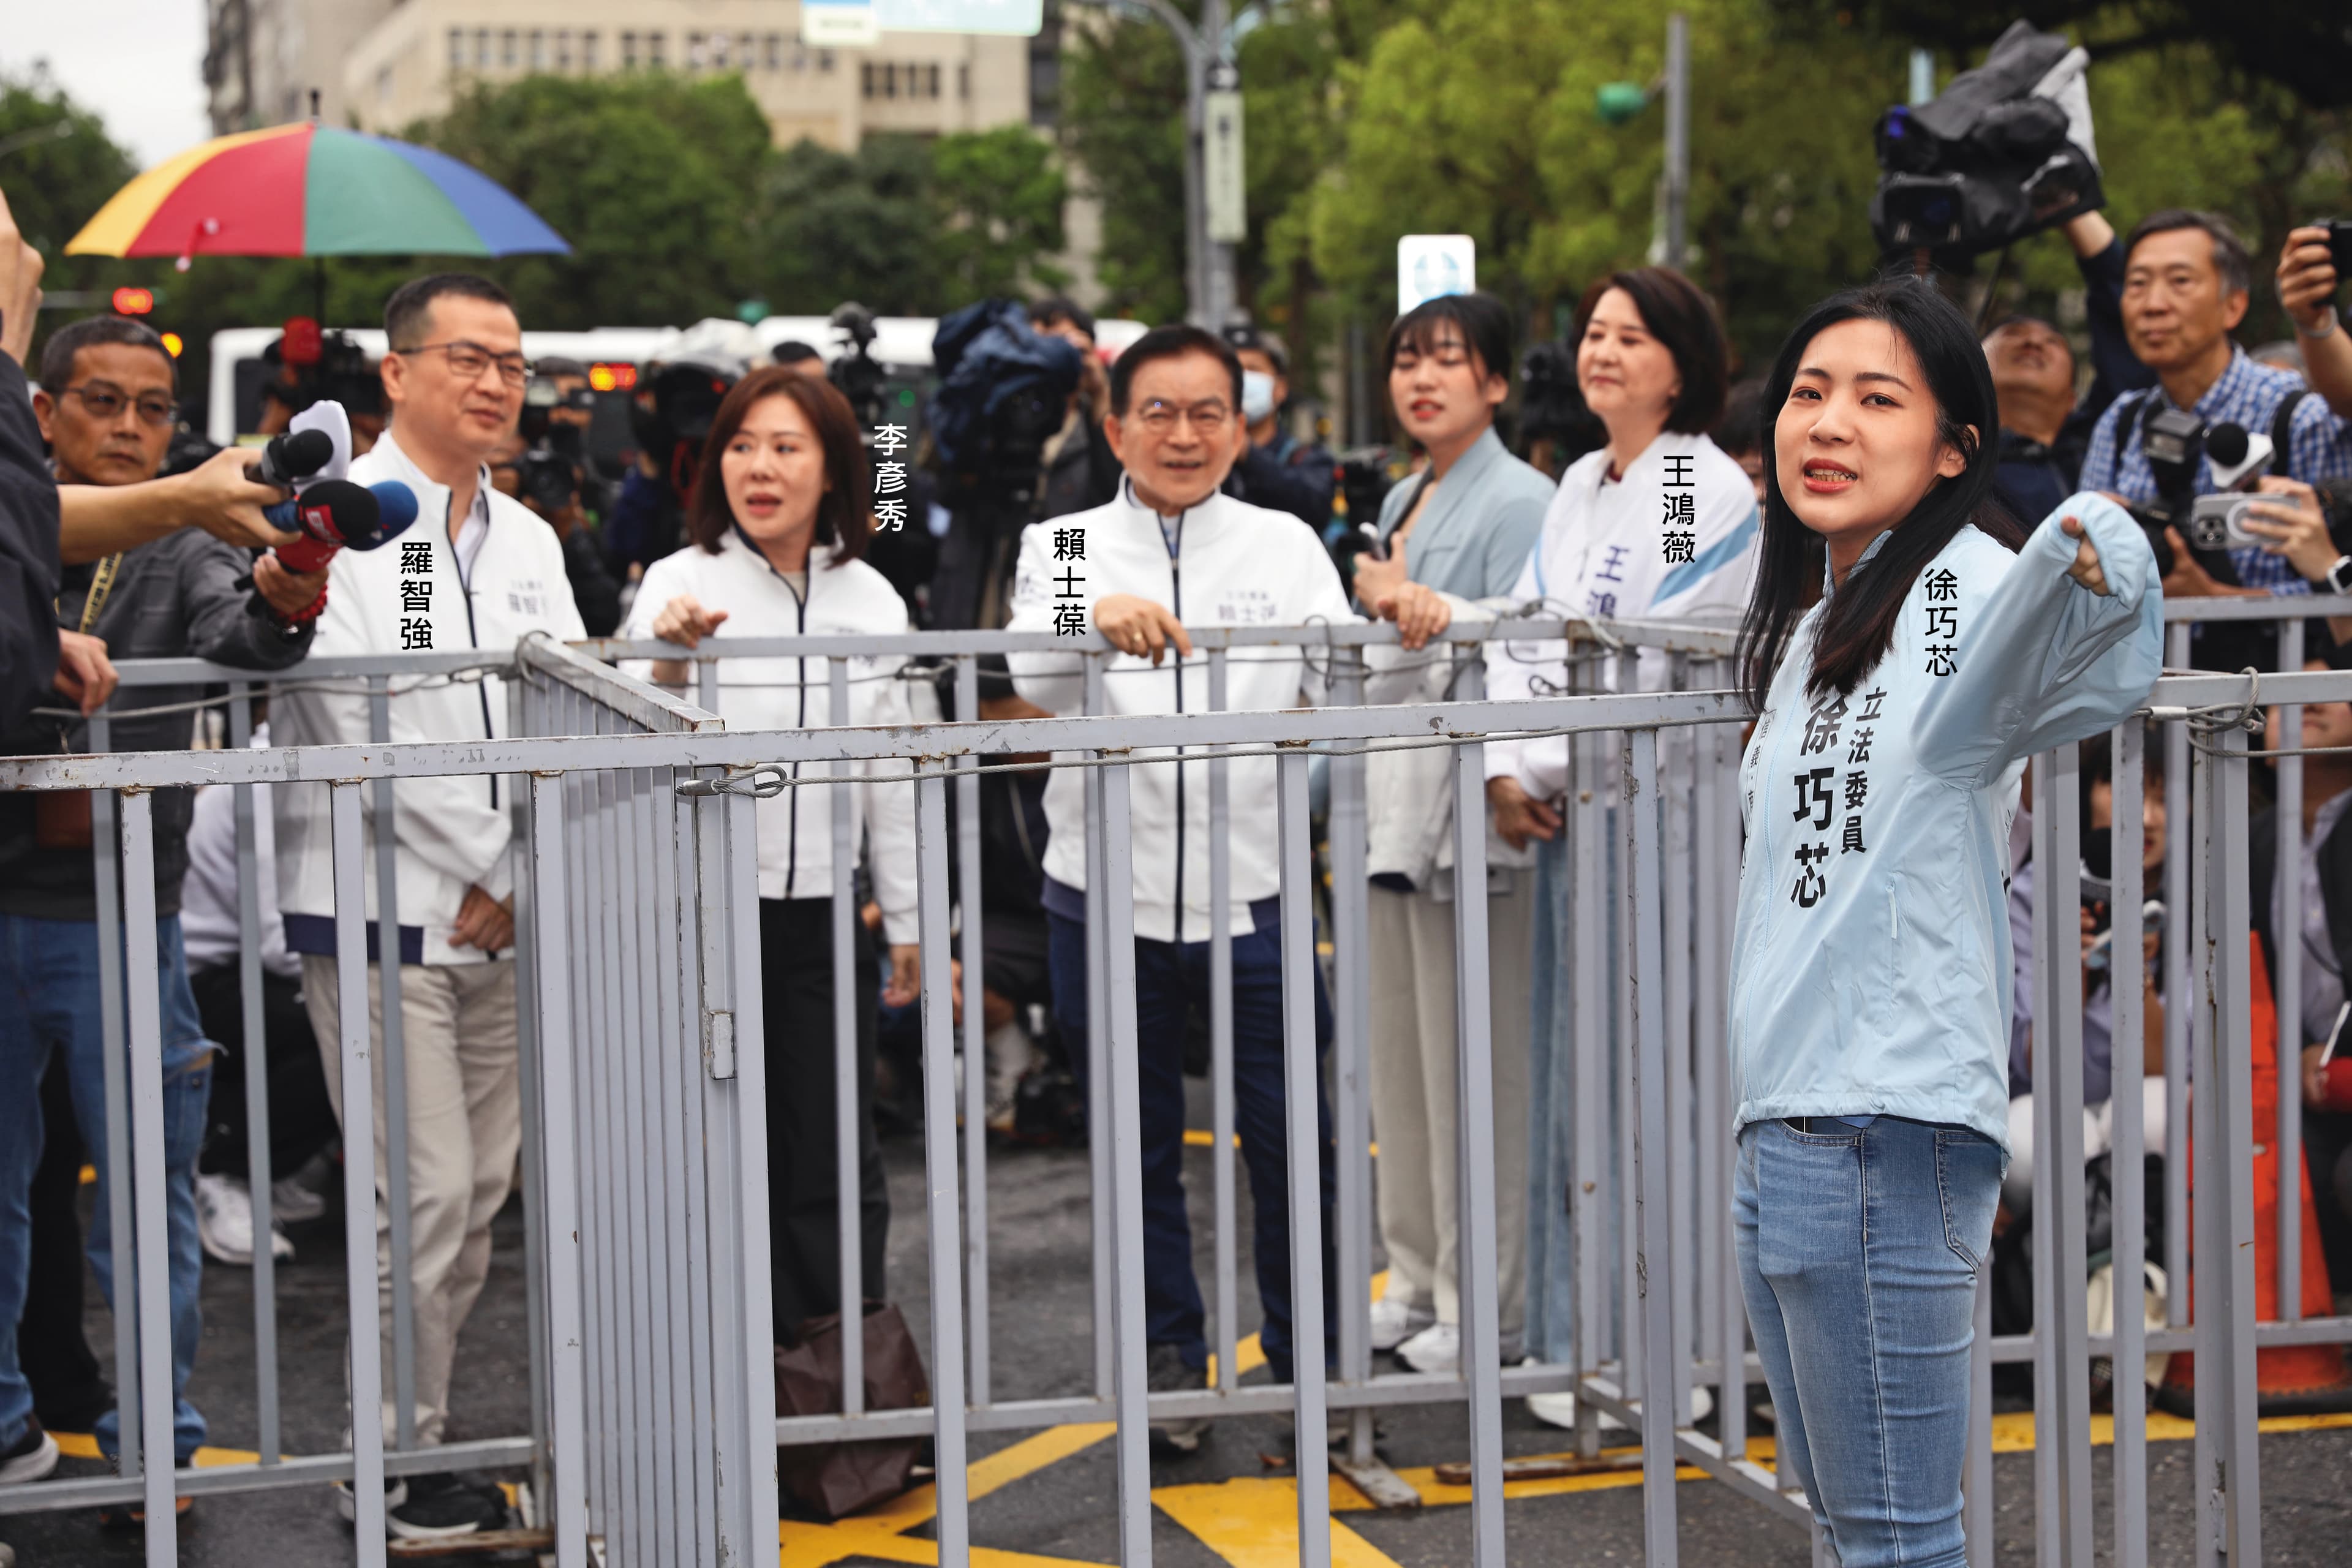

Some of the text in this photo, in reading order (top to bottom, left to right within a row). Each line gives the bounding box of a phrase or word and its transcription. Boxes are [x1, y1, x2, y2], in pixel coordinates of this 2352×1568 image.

[1790, 695, 1849, 908] 徐巧芯
[1841, 685, 1888, 854] 立法委員
